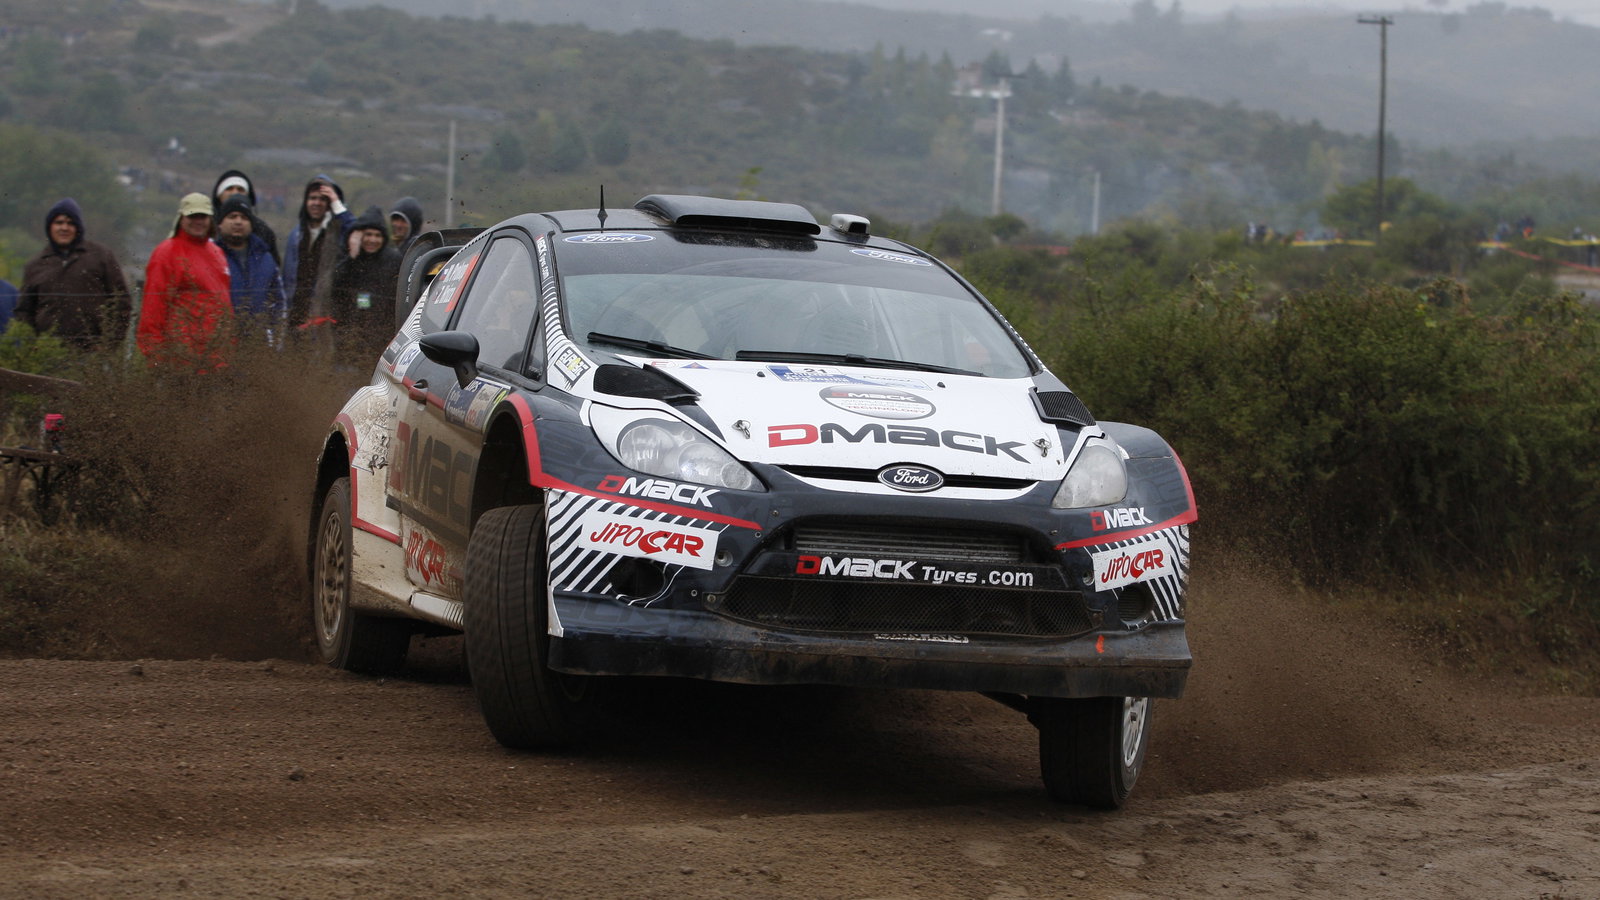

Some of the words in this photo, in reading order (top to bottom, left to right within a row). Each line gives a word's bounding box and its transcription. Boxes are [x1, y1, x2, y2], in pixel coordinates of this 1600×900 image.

[582, 233, 637, 242] Ford
[768, 423, 1031, 464] DMACK
[893, 468, 930, 484] Ford
[597, 475, 720, 508] DMACK
[1090, 507, 1154, 531] DMACK
[796, 555, 917, 580] DMACK
